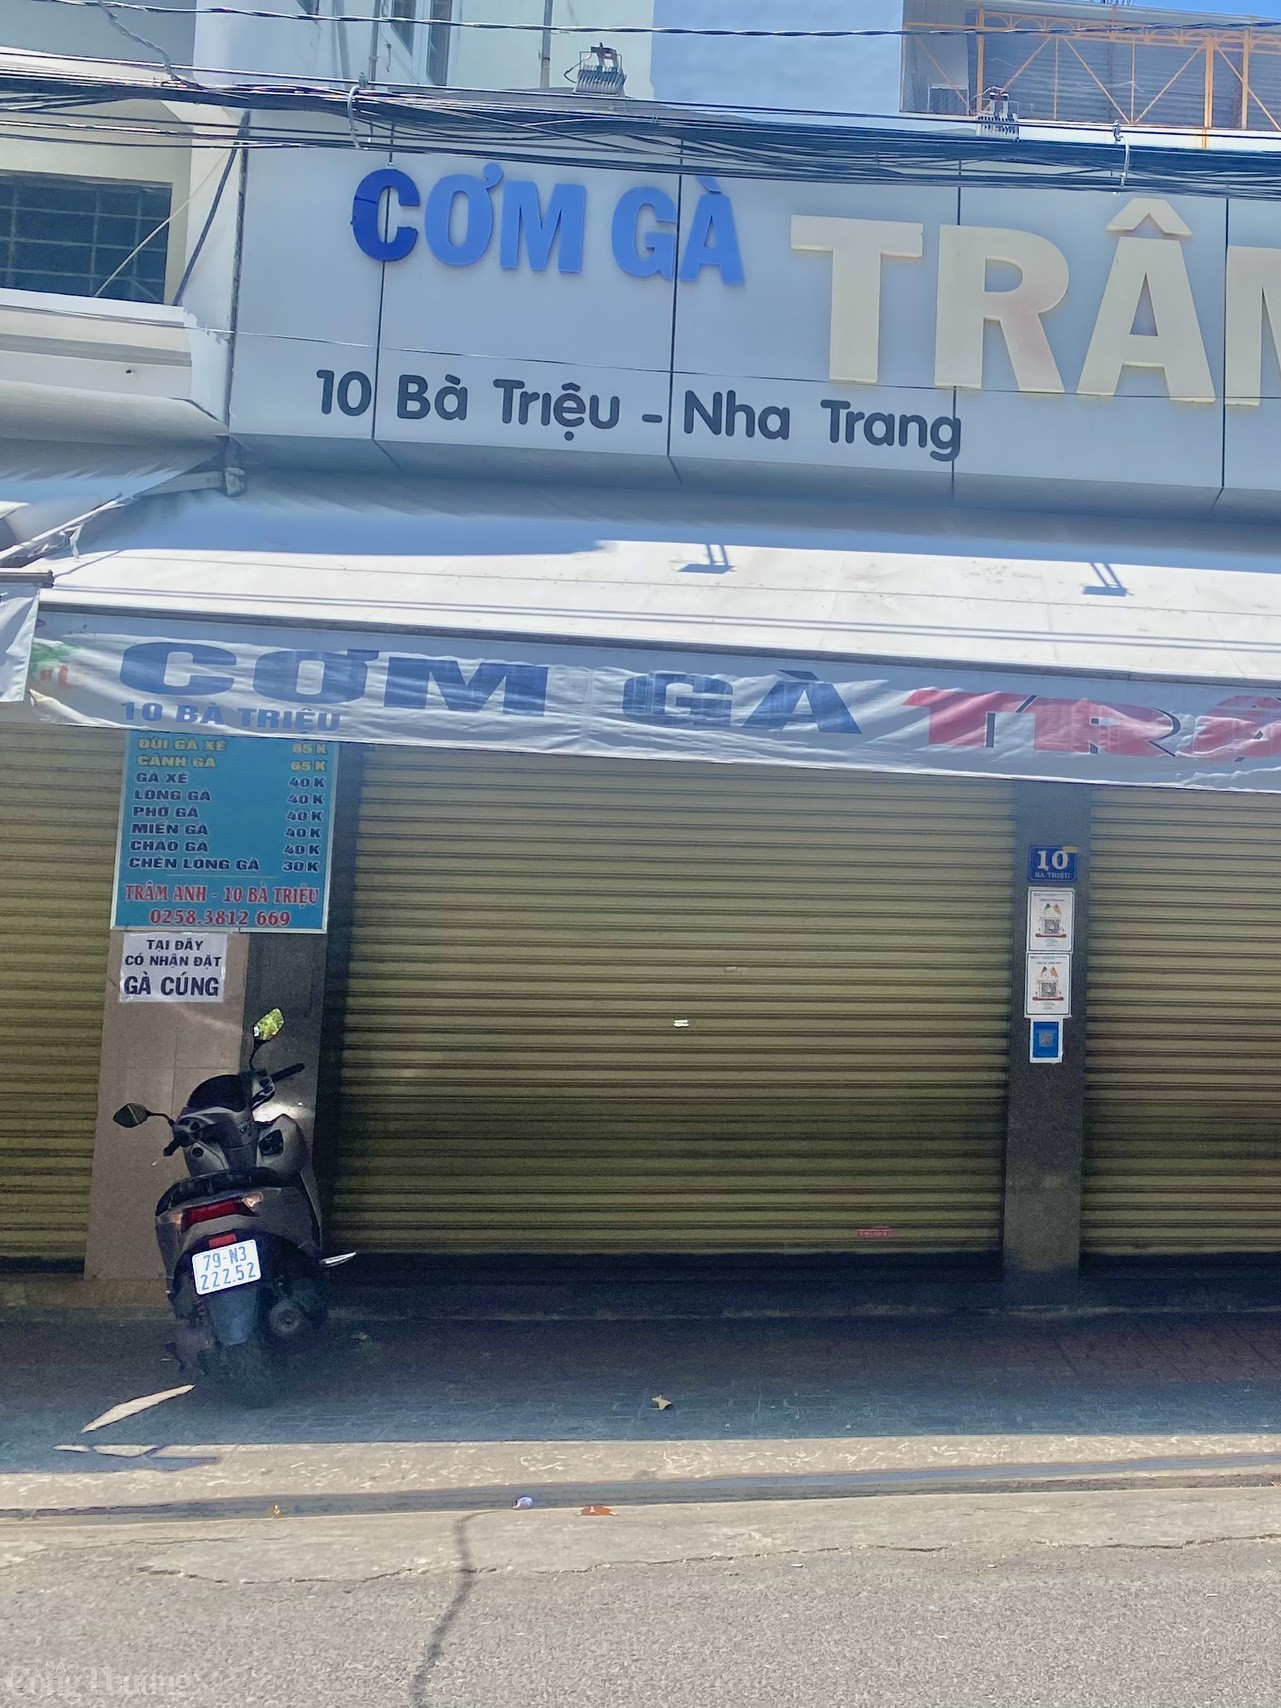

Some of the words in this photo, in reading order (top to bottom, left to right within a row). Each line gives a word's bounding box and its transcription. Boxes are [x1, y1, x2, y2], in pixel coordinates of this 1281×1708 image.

[351, 162, 586, 275] CƠM
[611, 176, 747, 286] GÀ
[316, 370, 372, 417] 10
[397, 373, 469, 421] Bà
[493, 379, 620, 442] Triệu
[684, 390, 791, 440] Nha
[820, 399, 962, 462] Trang
[118, 640, 549, 717] CƠM
[622, 670, 864, 736] GÀ
[121, 701, 163, 722] 10
[174, 700, 225, 725] BÀ
[236, 707, 341, 734] TRIỆU
[1036, 850, 1069, 872] 10
[124, 880, 169, 902] TRÂM
[172, 884, 208, 903] ANH
[223, 886, 244, 903] 10
[247, 882, 269, 904] BÀ
[273, 883, 320, 910] TRIỆU
[150, 909, 250, 926] 0258.3812
[256, 911, 292, 927] 669
[146, 938, 171, 953] TẠI
[174, 935, 204, 951] ĐÂY
[124, 953, 145, 966] CÓ
[149, 954, 189, 971] NHẬN
[123, 970, 151, 996] GÀ
[160, 970, 220, 998] CÚNG
[201, 1262, 257, 1291] 222.52
